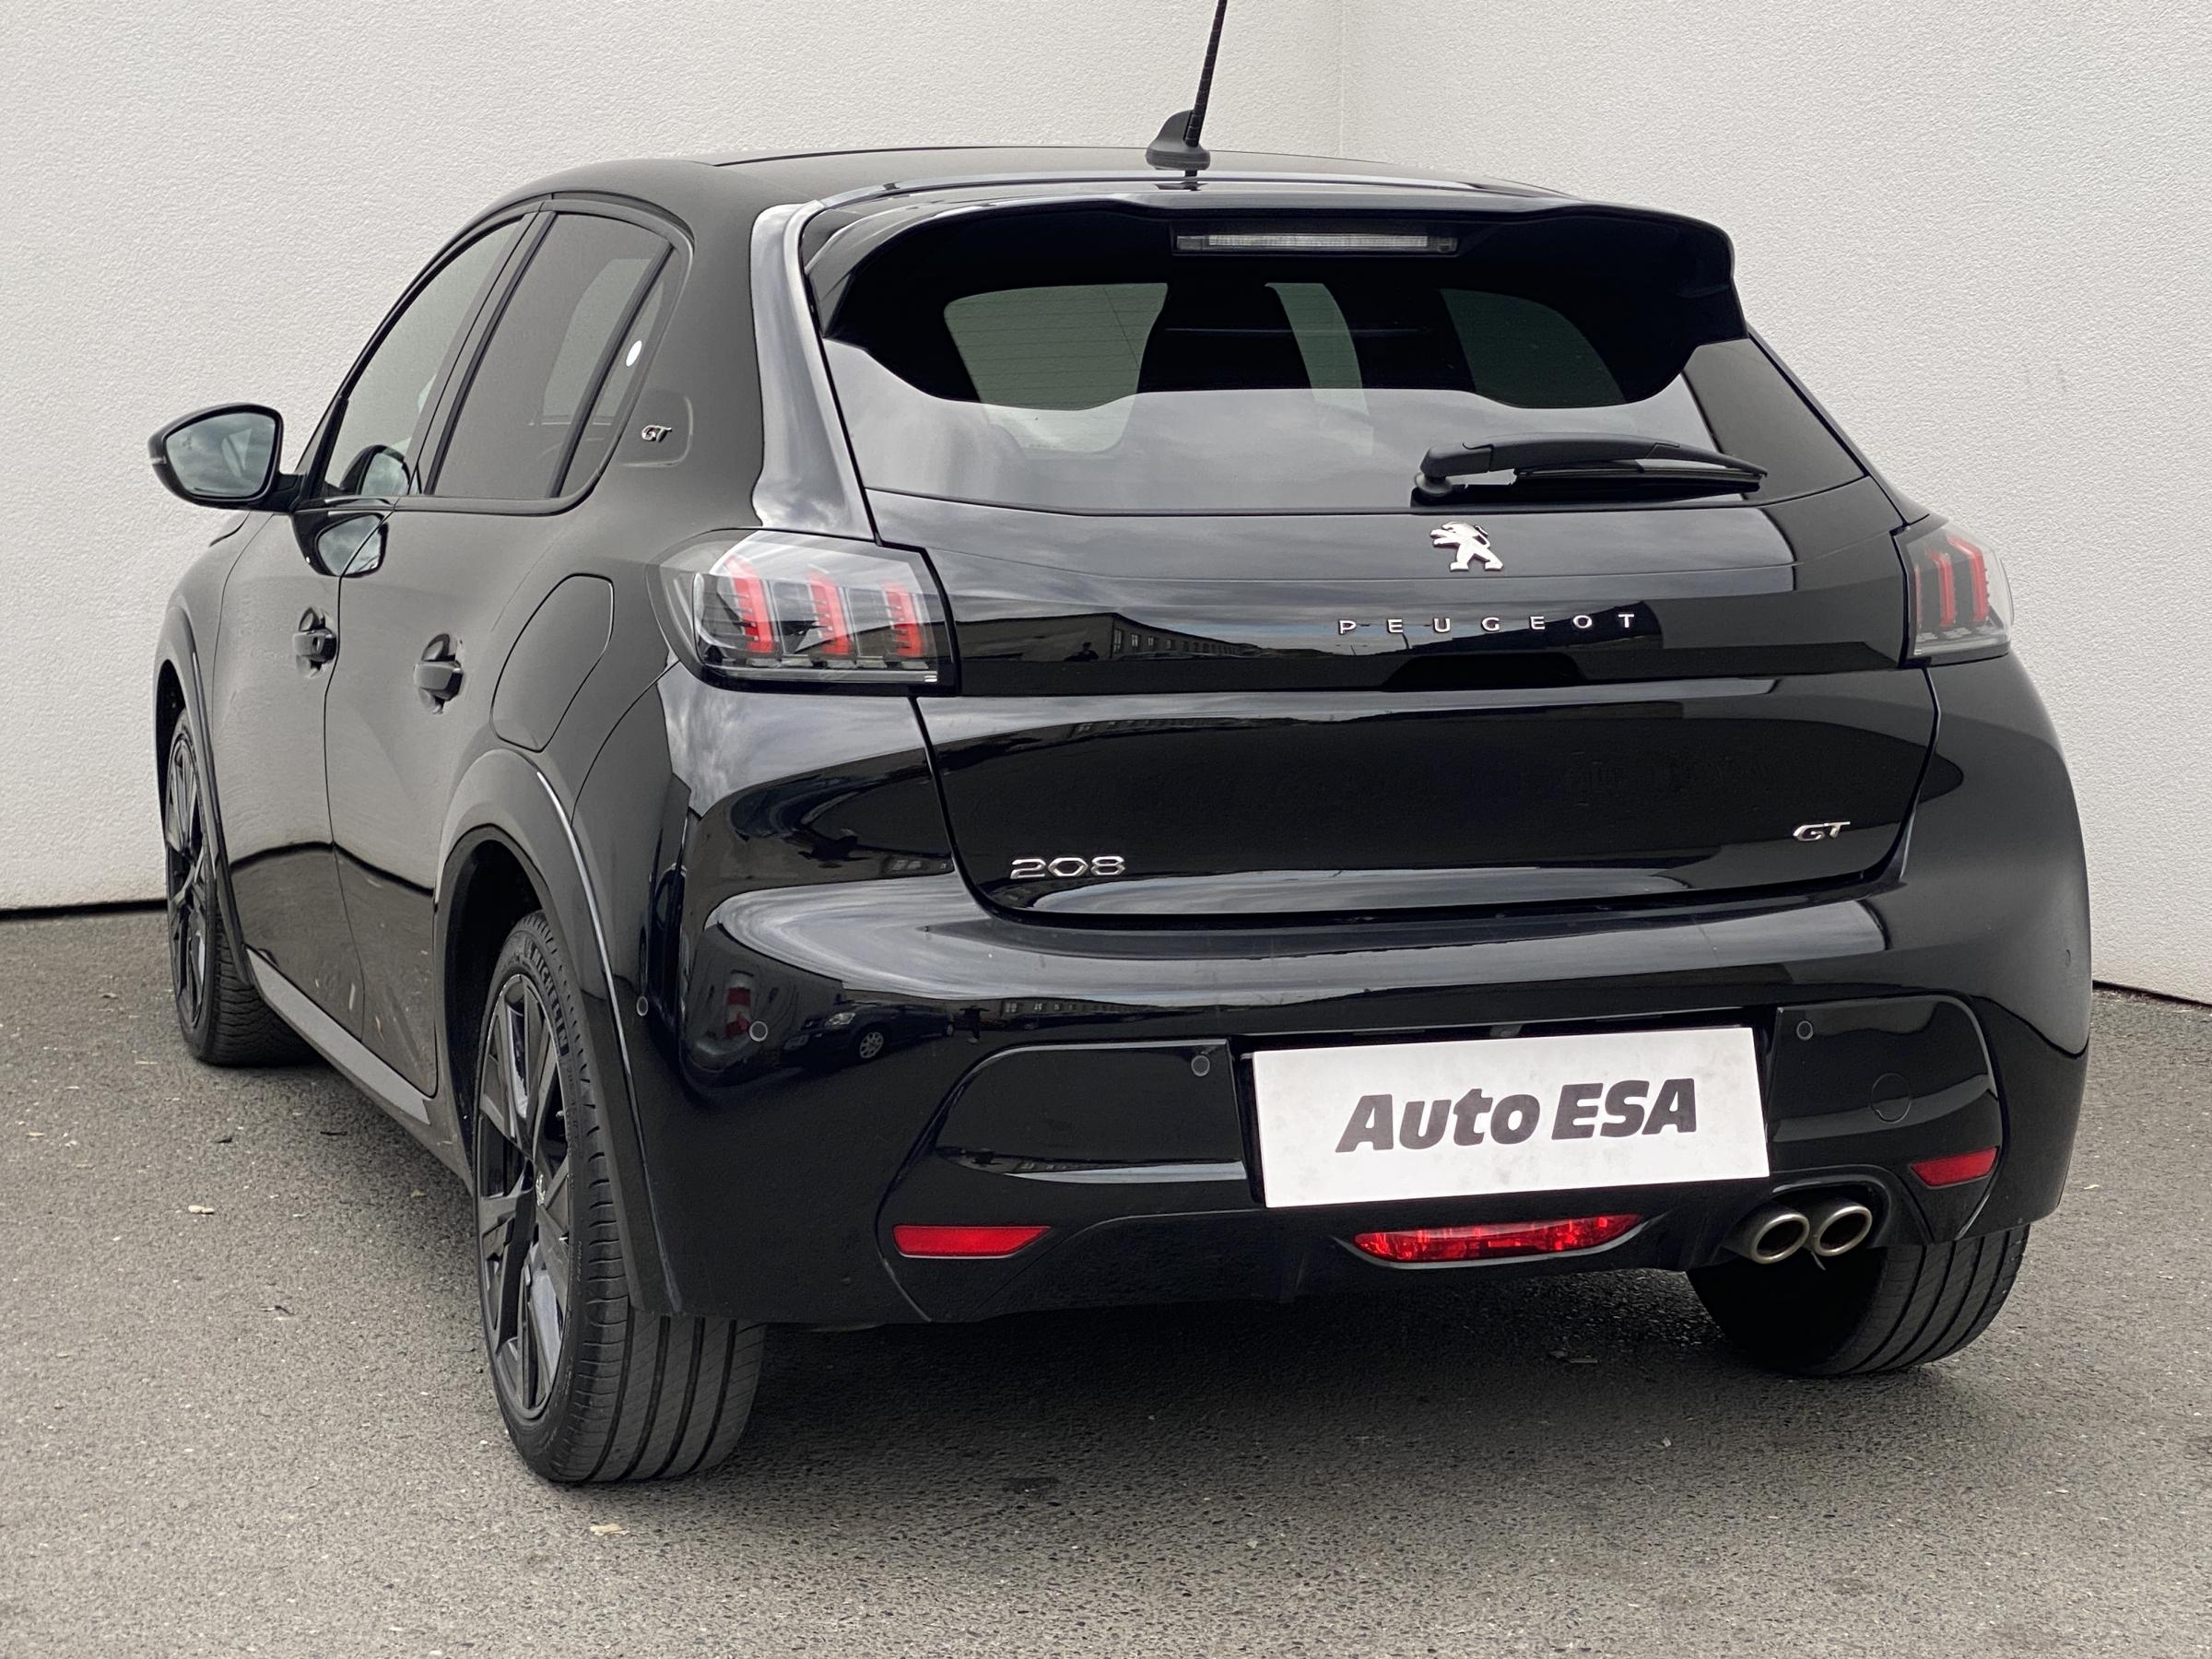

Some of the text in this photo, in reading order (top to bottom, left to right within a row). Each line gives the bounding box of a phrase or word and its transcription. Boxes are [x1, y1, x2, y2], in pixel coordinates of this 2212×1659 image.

[641, 425, 672, 442] GT
[1338, 613, 1636, 635] PEUGEOT
[1793, 821, 1851, 841] GT
[1010, 856, 1125, 879] 208
[530, 945, 570, 1049] MICHELIN
[1335, 1077, 1697, 1153] Auto ESA
